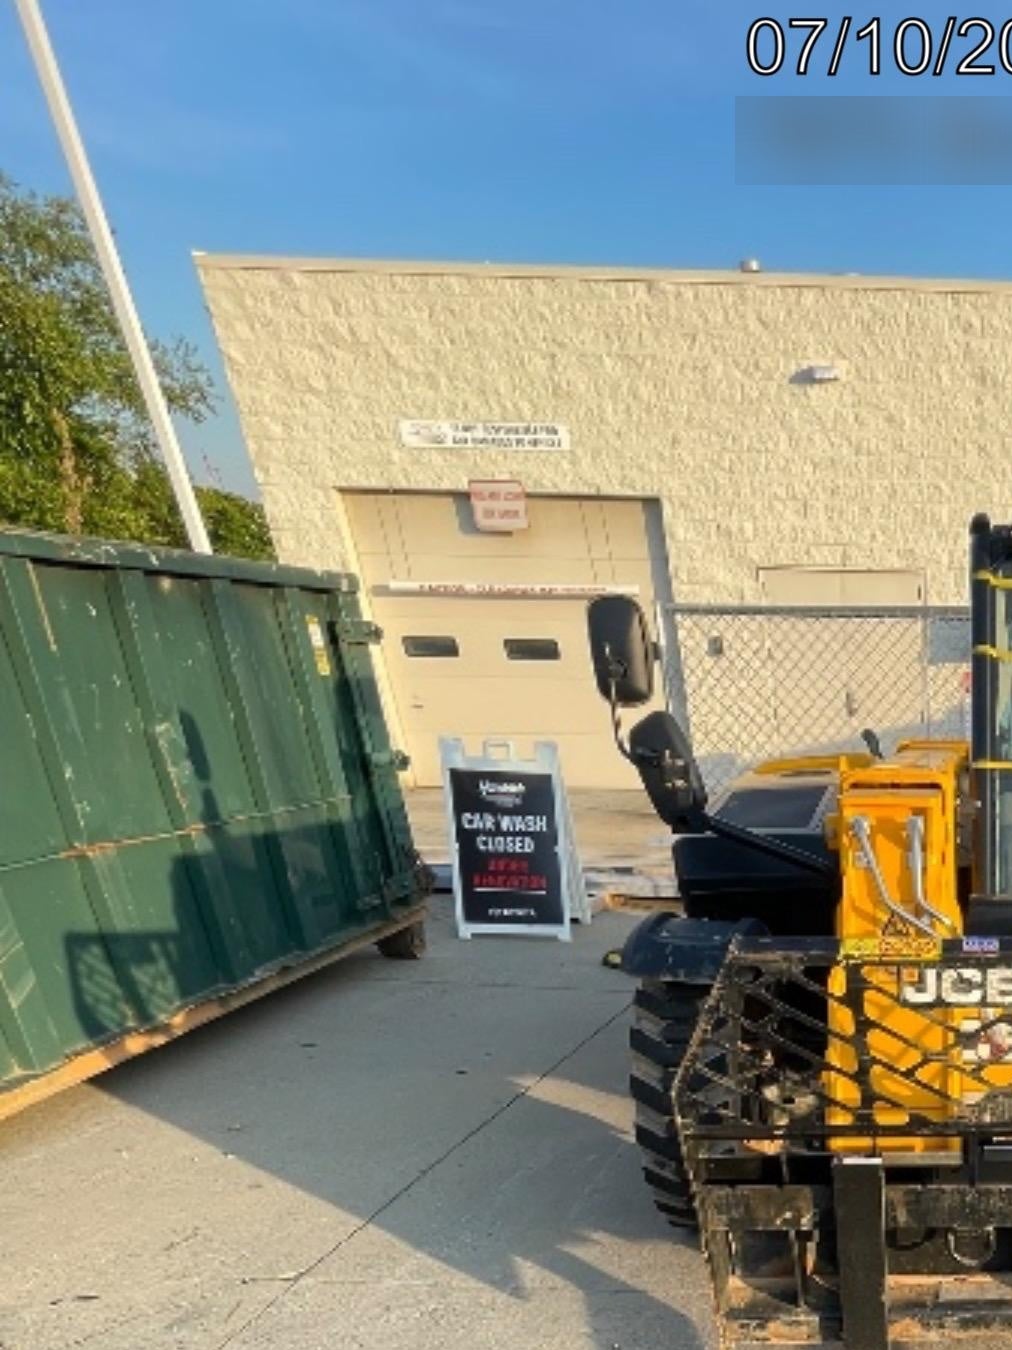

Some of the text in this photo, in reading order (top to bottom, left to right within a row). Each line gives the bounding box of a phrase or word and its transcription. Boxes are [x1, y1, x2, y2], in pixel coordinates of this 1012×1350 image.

[461, 812, 547, 832] CAR WASH
[476, 835, 536, 854] CLOSED
